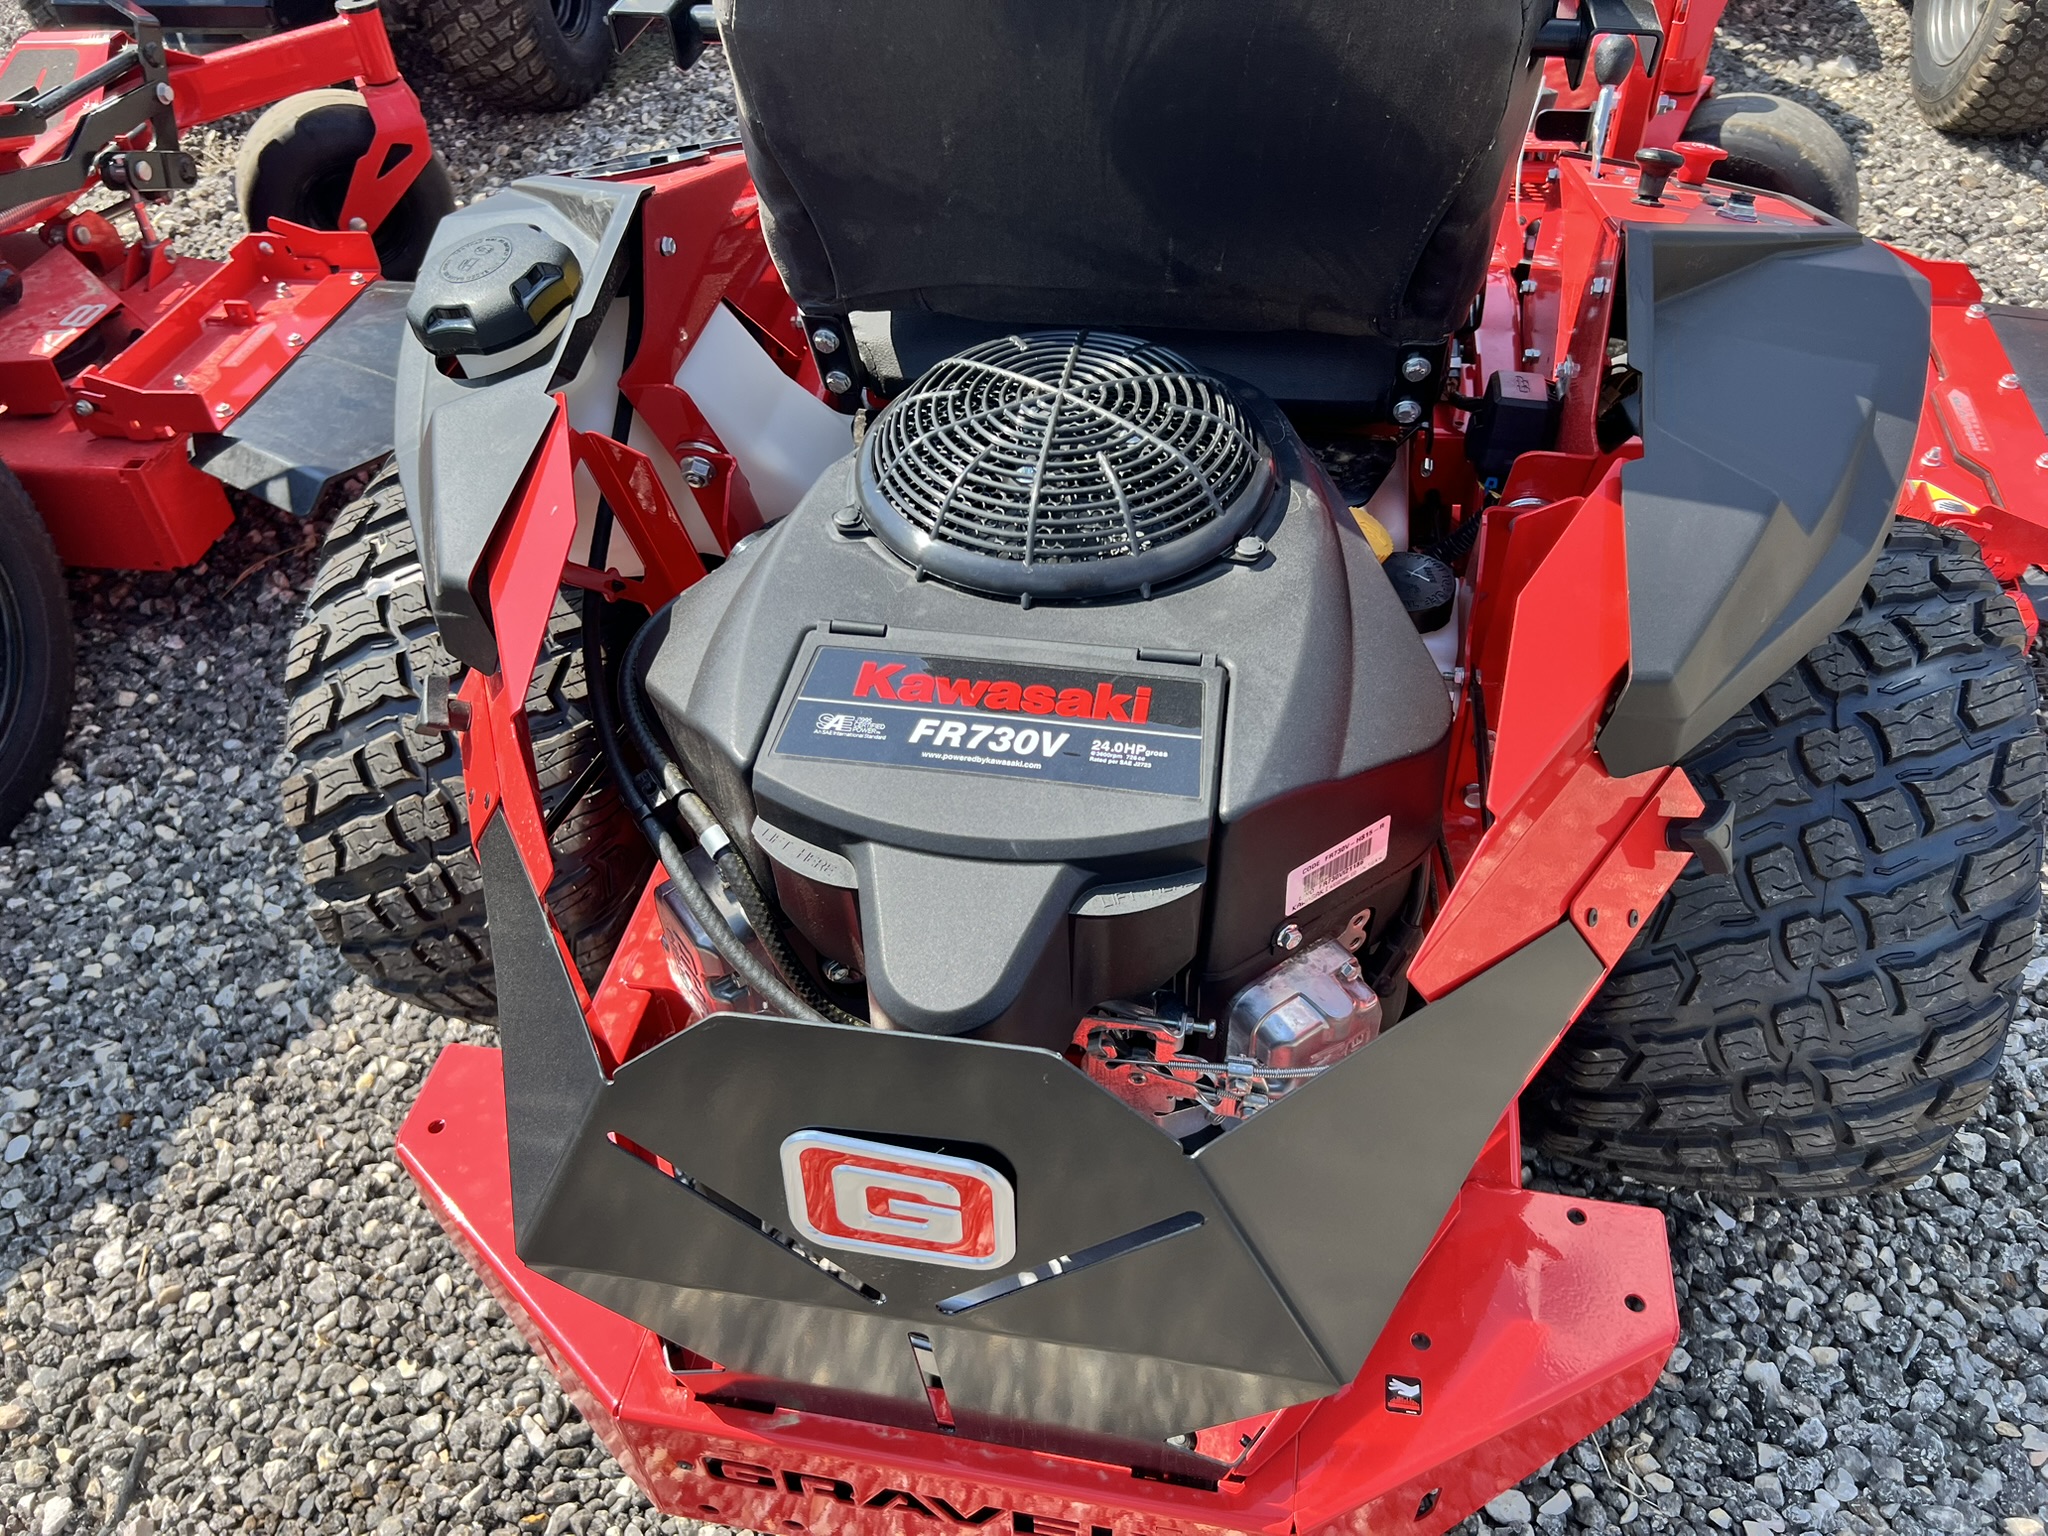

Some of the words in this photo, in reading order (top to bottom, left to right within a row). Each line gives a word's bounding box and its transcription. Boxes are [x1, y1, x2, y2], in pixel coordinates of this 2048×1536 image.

[852, 660, 1153, 724] Kawasaki
[815, 713, 855, 732] SAE
[832, 730, 864, 739] International
[863, 732, 887, 741] Standard
[908, 718, 1071, 758] FR730V
[921, 750, 1042, 770] www.poweredbykawasaki.com
[1089, 756, 1107, 764] Rated
[1119, 759, 1133, 767] SAE
[761, 828, 794, 850] LIFT
[796, 848, 838, 877] HERE
[1302, 860, 1321, 875] CODE
